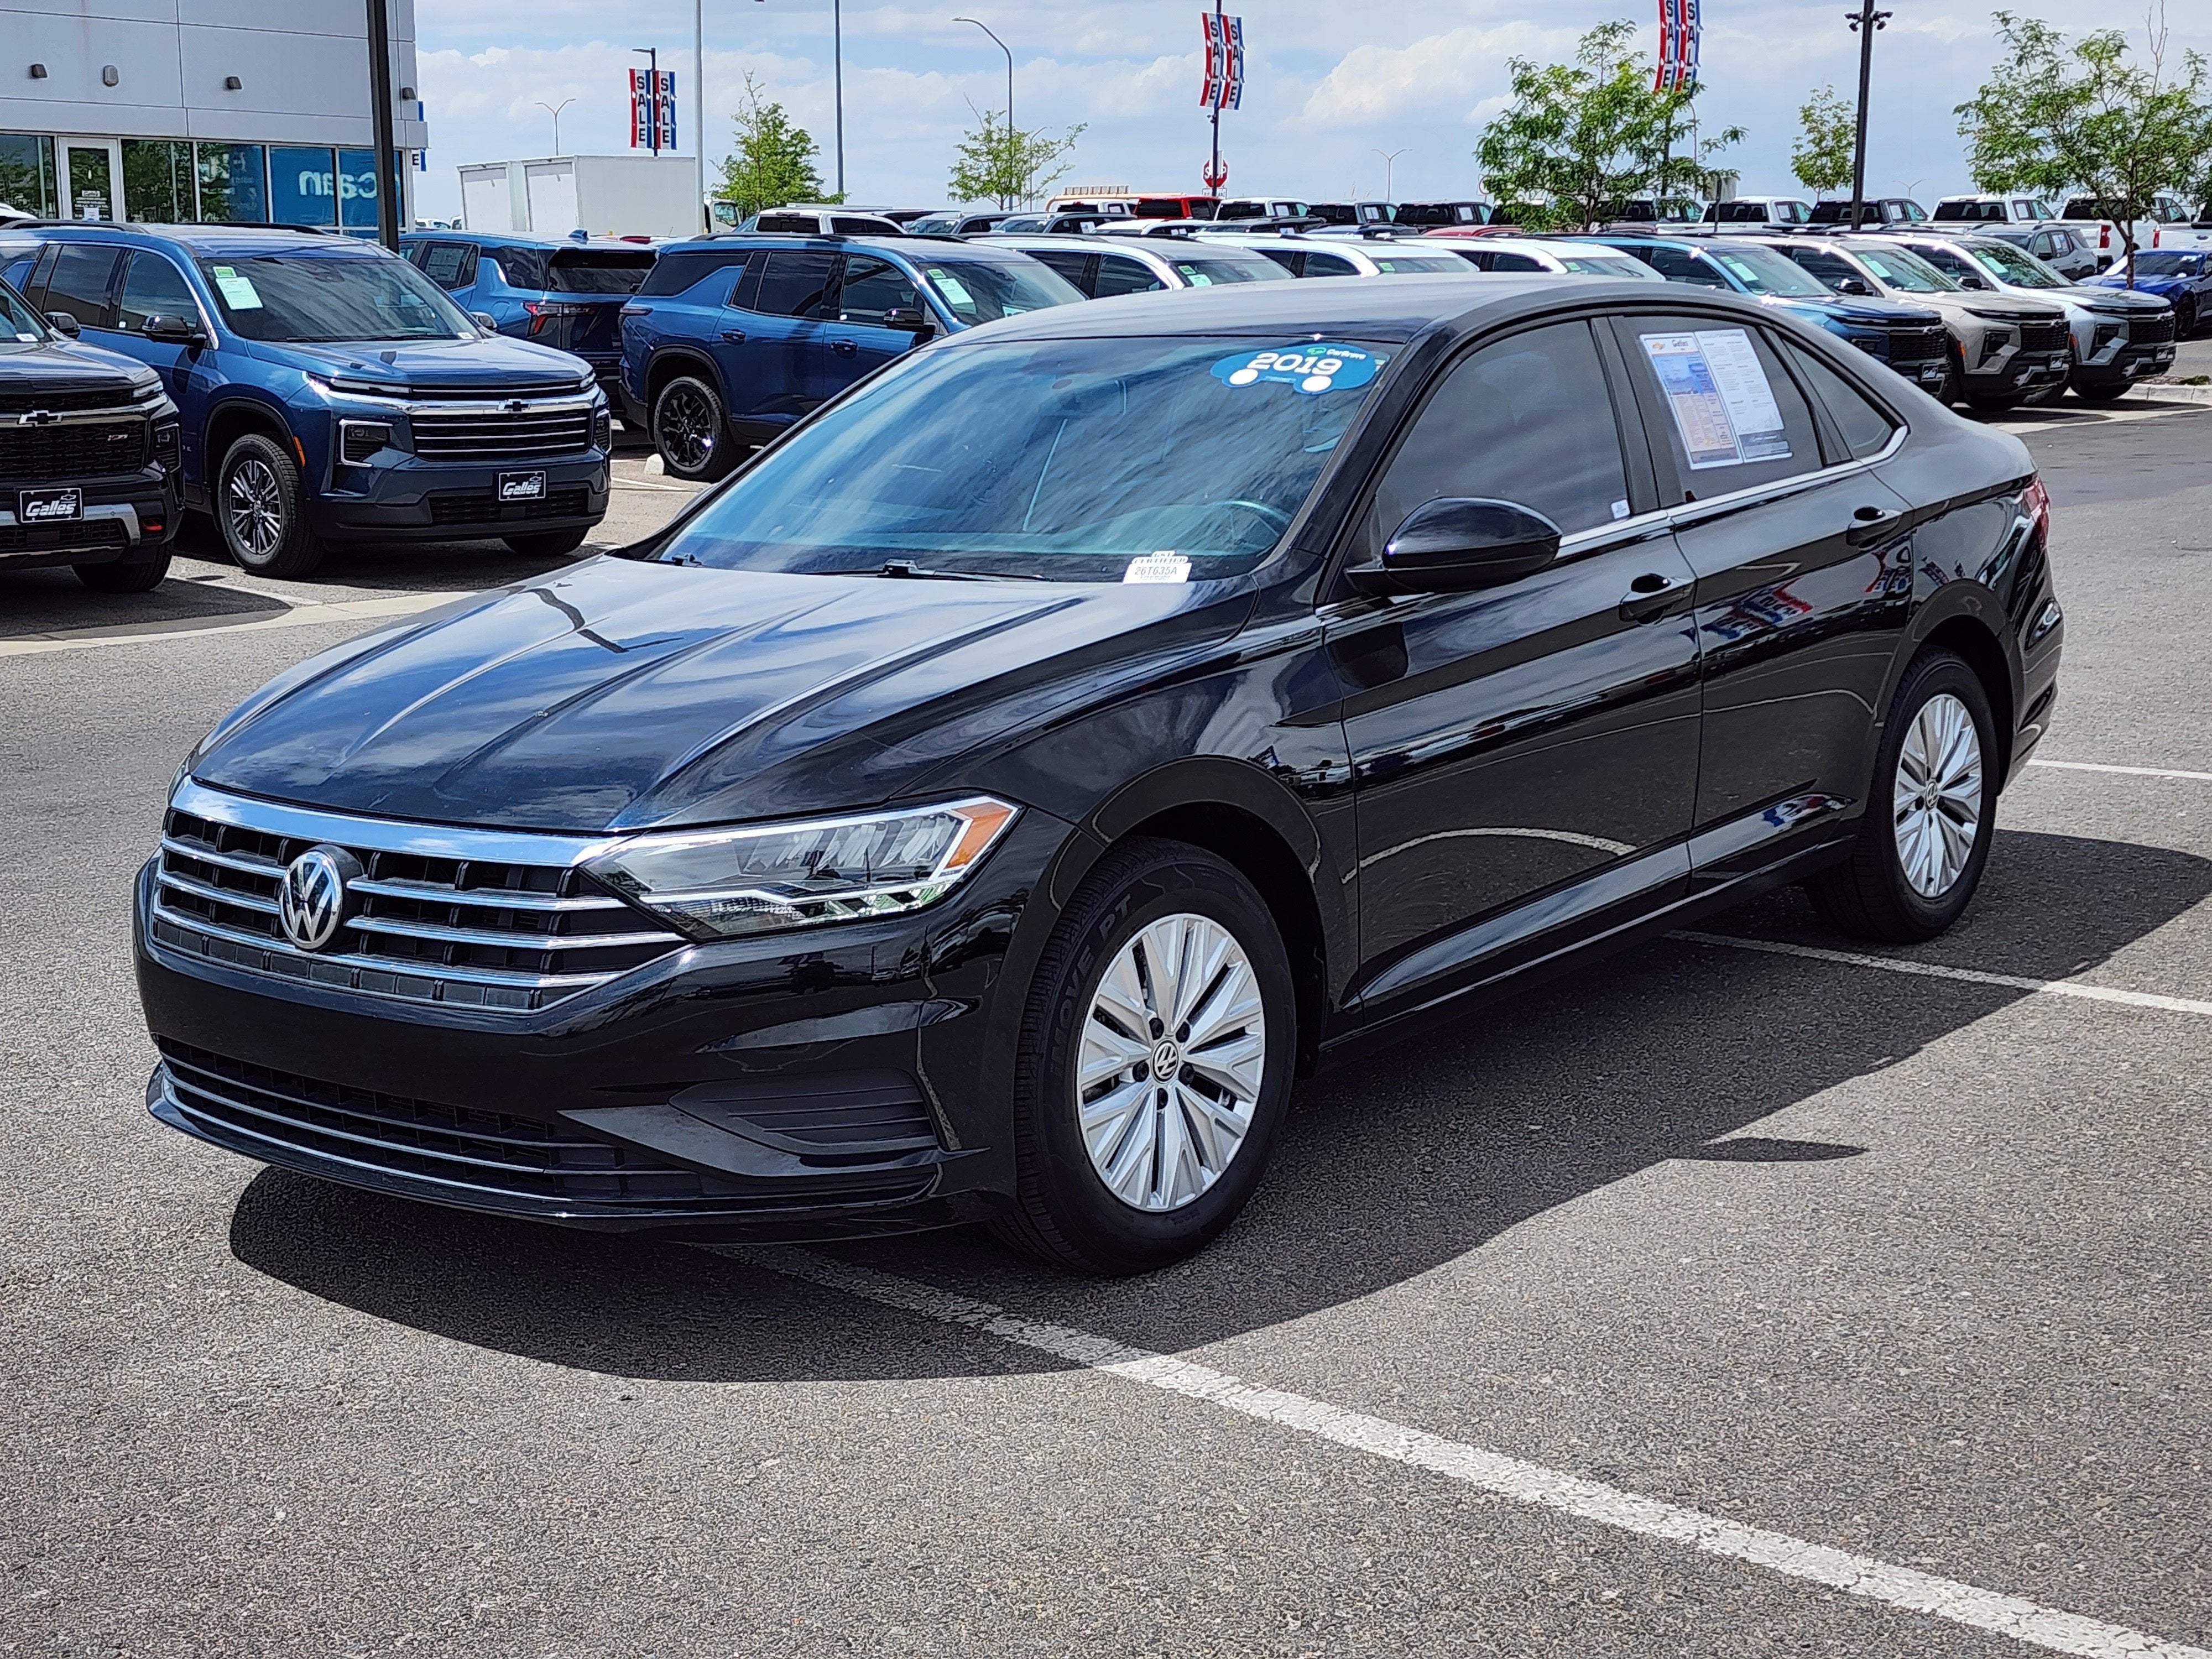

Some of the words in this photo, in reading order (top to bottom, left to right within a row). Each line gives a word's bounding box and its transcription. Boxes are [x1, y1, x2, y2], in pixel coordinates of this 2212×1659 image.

[1209, 21, 1220, 100] SALE
[1229, 24, 1240, 102] SALE
[1662, 0, 1674, 87] SALE
[637, 76, 646, 142] SALE
[661, 77, 670, 143] SALE
[1204, 166, 1227, 179] SP
[1246, 352, 1343, 375] 2019
[25, 500, 77, 517] Galles
[502, 481, 542, 496] Galles
